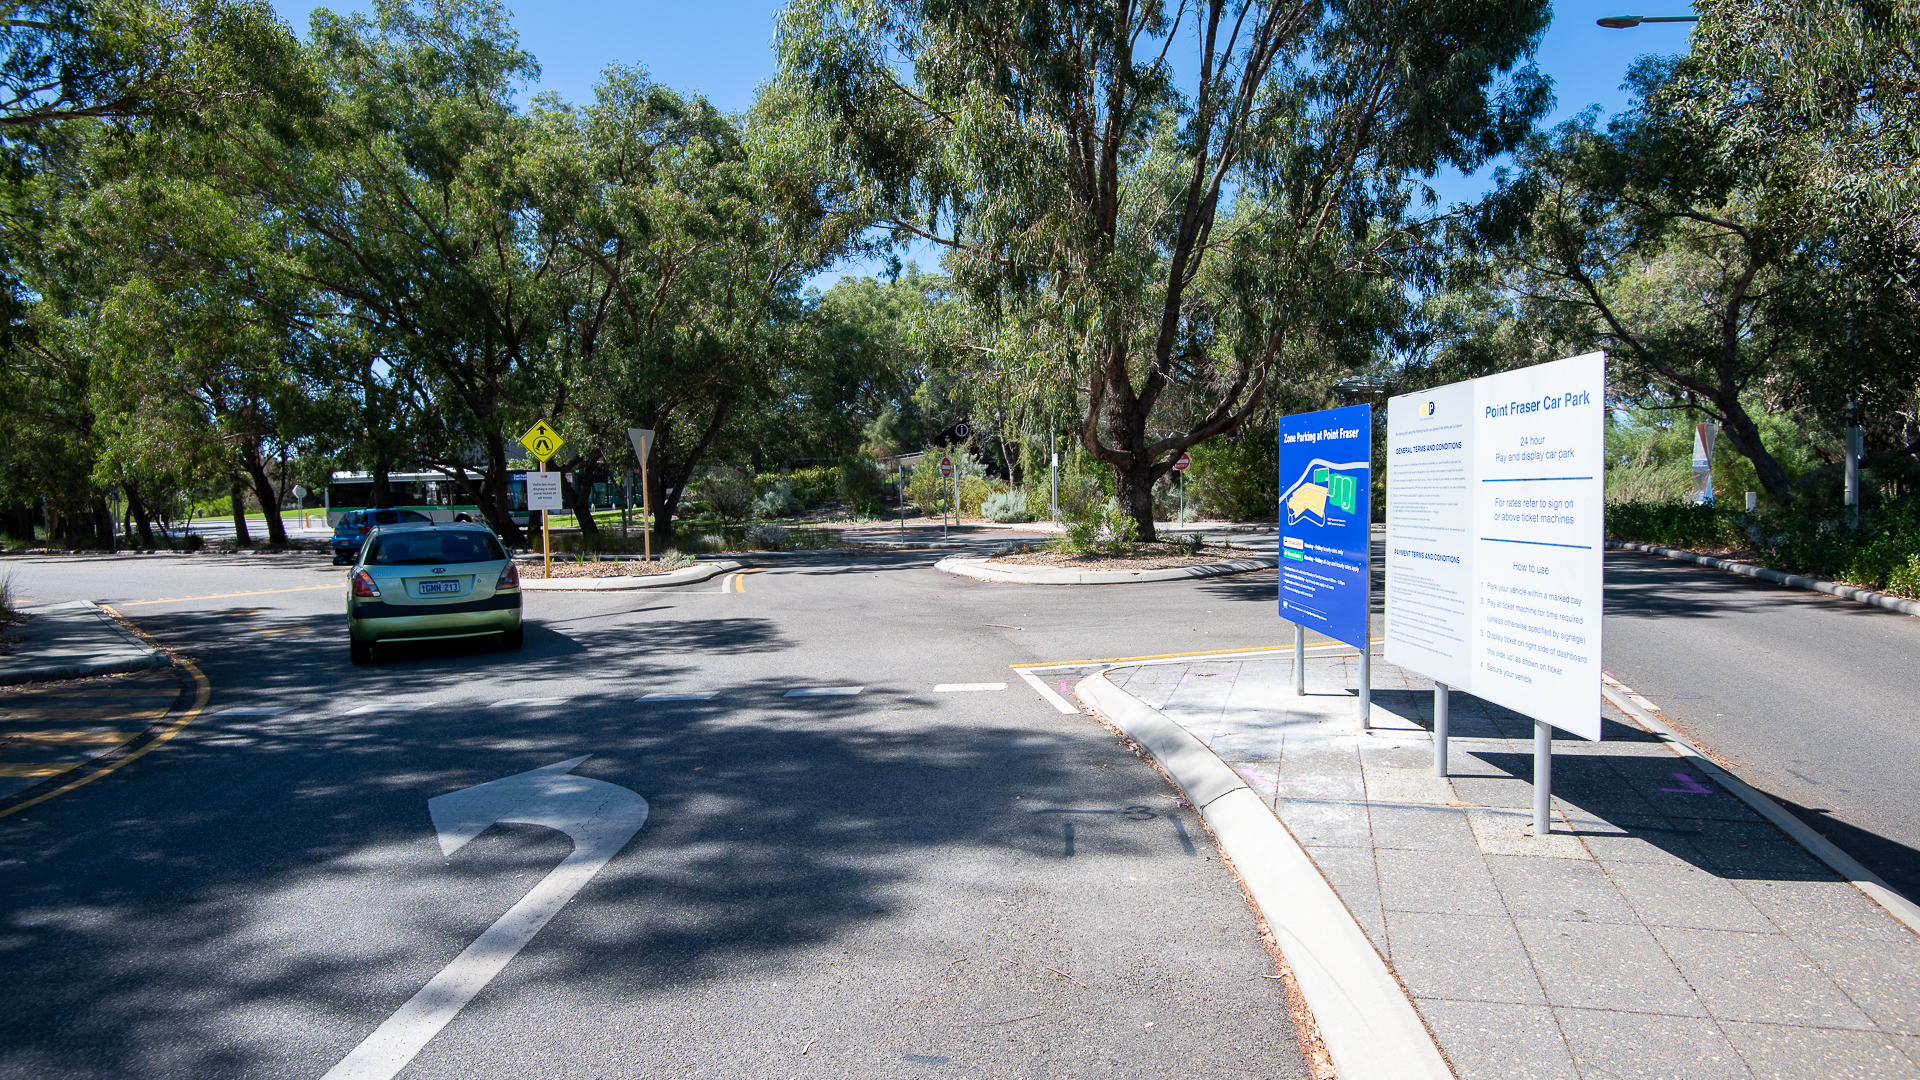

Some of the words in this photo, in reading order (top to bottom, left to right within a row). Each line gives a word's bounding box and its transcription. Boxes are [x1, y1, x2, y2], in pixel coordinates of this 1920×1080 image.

[1486, 404, 1508, 418] Point
[1510, 401, 1540, 415] Fraser
[1544, 396, 1561, 410] Car
[1565, 390, 1590, 407] Park
[1284, 434, 1296, 443] Zone
[1297, 431, 1316, 443] Parking
[1317, 431, 1322, 440] at
[1324, 429, 1338, 440] Point
[1340, 428, 1359, 439] Fraser
[1520, 437, 1528, 446] 24
[1530, 436, 1545, 445] hour
[1436, 442, 1462, 450] CONDITIONS
[1496, 453, 1507, 464] Pay
[1508, 452, 1520, 461] and
[1521, 450, 1544, 462] display
[1546, 450, 1557, 459] car
[1559, 448, 1574, 461] park
[1495, 498, 1505, 507] For
[1506, 499, 1521, 507] rates
[1523, 498, 1538, 508] refer
[1540, 499, 1546, 508] to
[1548, 498, 1563, 510] sign
[1565, 500, 1574, 508] on
[1494, 513, 1500, 521] or
[1502, 512, 1520, 521] above
[1522, 513, 1538, 522] ticket
[1540, 514, 1574, 524] machines
[1434, 554, 1460, 564] CONDITIONS
[1513, 562, 1527, 572] How
[1529, 563, 1535, 573] to
[1537, 565, 1549, 575] use
[1487, 582, 1498, 590] Park
[1510, 586, 1526, 595] vehicle
[1528, 588, 1542, 598] within
[1549, 593, 1569, 603] marked
[1571, 596, 1582, 607] bay
[1481, 597, 1485, 605] 2.
[1487, 598, 1496, 608] Pay
[1502, 601, 1515, 610] ticket
[1516, 603, 1536, 615] machine
[1546, 610, 1558, 619] time
[1560, 614, 1583, 624] required
[1487, 615, 1503, 625] (unless
[1504, 618, 1527, 630] otherwise
[1528, 623, 1551, 636] specified
[1553, 629, 1559, 639] by
[1561, 632, 1586, 645] signage)
[1480, 629, 1485, 637] 3.
[1487, 631, 1503, 642] Display
[1504, 636, 1517, 645] ticket
[1518, 639, 1524, 647] on
[1525, 641, 1536, 652] right
[1538, 645, 1549, 654] side
[1550, 647, 1555, 655] of
[1557, 649, 1587, 663] dashboard
[1496, 650, 1505, 659] side
[1522, 657, 1538, 669] shown
[1548, 665, 1562, 676] ticket
[1480, 661, 1485, 669] 4.
[1486, 663, 1502, 674] Secure
[1503, 669, 1514, 678] your
[1515, 672, 1532, 684] vehicle
